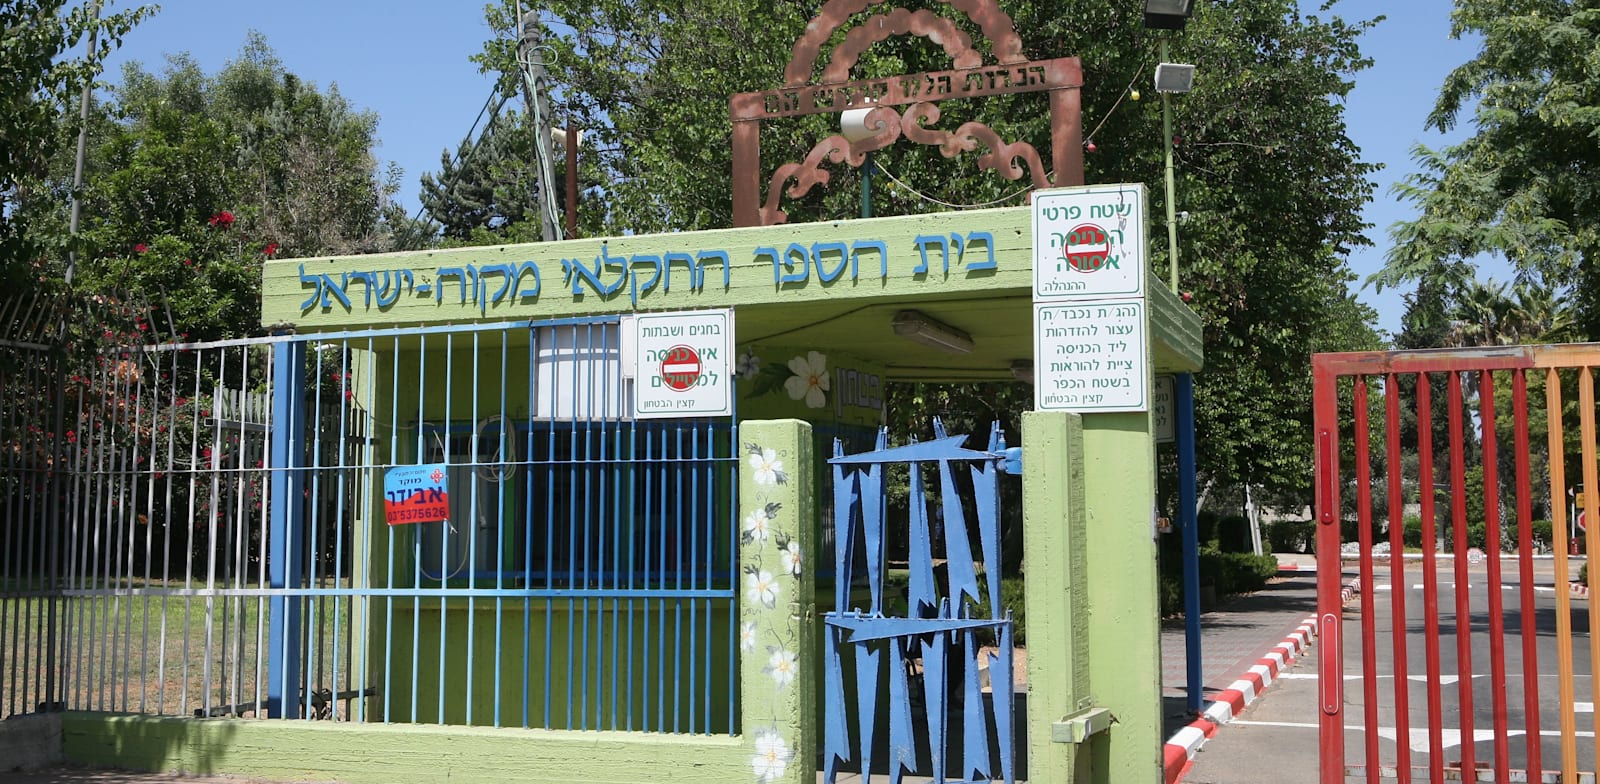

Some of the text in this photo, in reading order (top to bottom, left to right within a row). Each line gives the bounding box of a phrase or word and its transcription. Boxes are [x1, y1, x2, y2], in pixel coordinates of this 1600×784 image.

[962, 66, 1045, 91] הנרות
[1042, 203, 1132, 221] שטח פרטי
[1050, 229, 1124, 247] הכניסה
[1056, 255, 1120, 272] אסורה
[299, 231, 997, 315] בית הספר החקלאי מקוה-ישראל
[1043, 307, 1136, 320] נהג/ת נכבד/ת
[642, 324, 720, 338] בחגים ושבתות
[1046, 324, 1133, 337] עצור להזדהות
[1056, 340, 1127, 354] ליד הכניסה
[646, 348, 718, 364] אין כניסה
[1050, 359, 1133, 372] ציית להוראות
[651, 370, 718, 388] למטיילים
[1053, 378, 1130, 389] בשטח הכפר
[836, 368, 881, 417] בטחון
[1044, 394, 1104, 405] קצין הבטחון
[643, 399, 695, 410] קצין הבטחון
[398, 478, 422, 486] מוקד
[387, 486, 443, 507] אבידר
